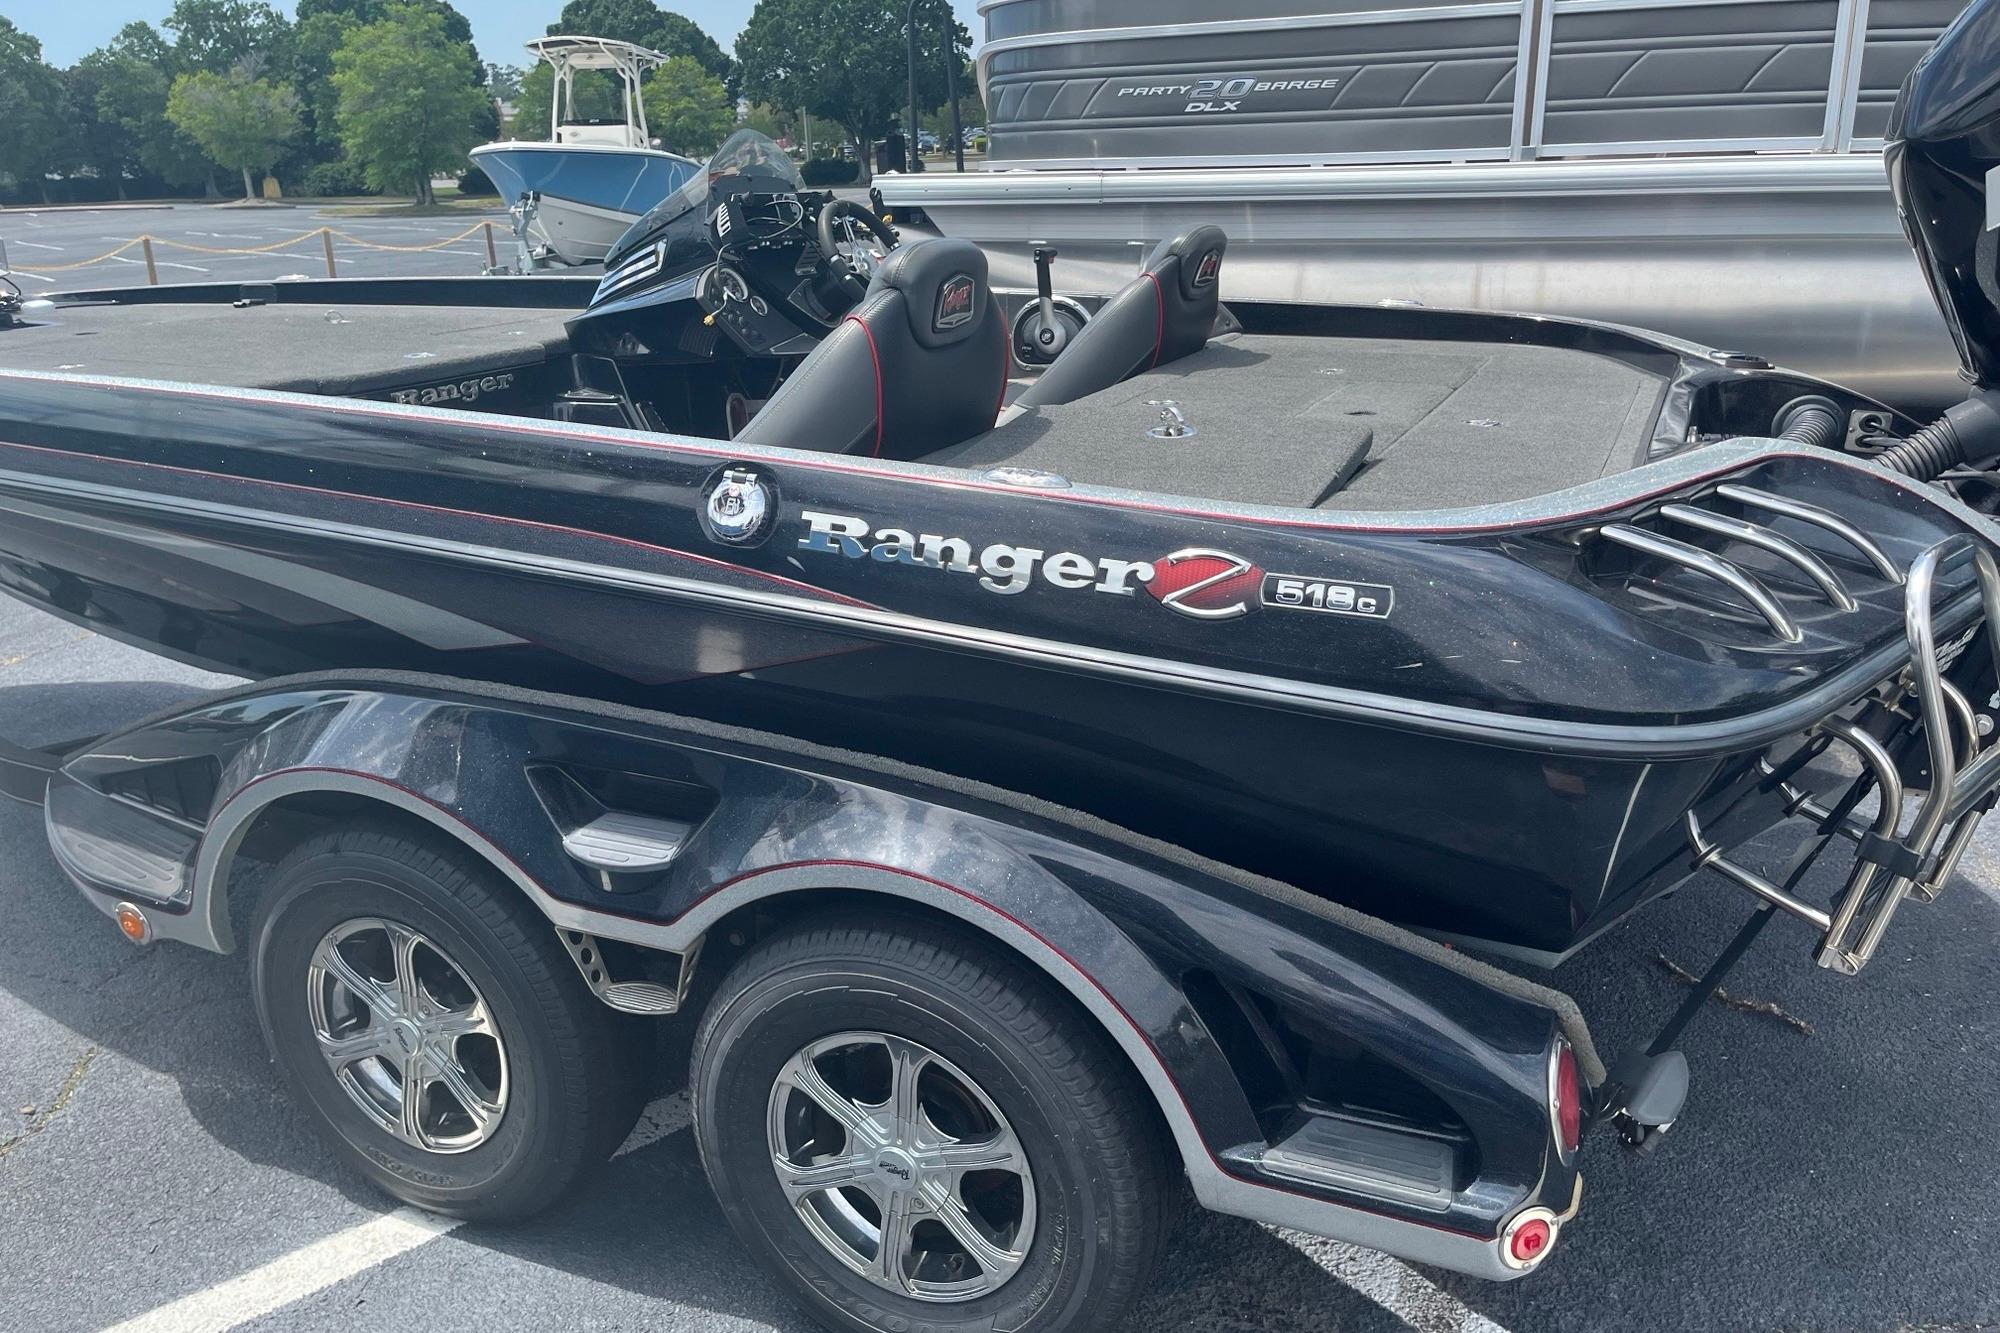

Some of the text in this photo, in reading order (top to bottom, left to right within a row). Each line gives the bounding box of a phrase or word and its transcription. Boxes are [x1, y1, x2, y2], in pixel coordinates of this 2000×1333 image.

[1117, 77, 1340, 100] PARTY 20 BARGE
[1184, 101, 1241, 113] DLX
[390, 373, 514, 405] Ranger
[798, 510, 1156, 597] Ranger
